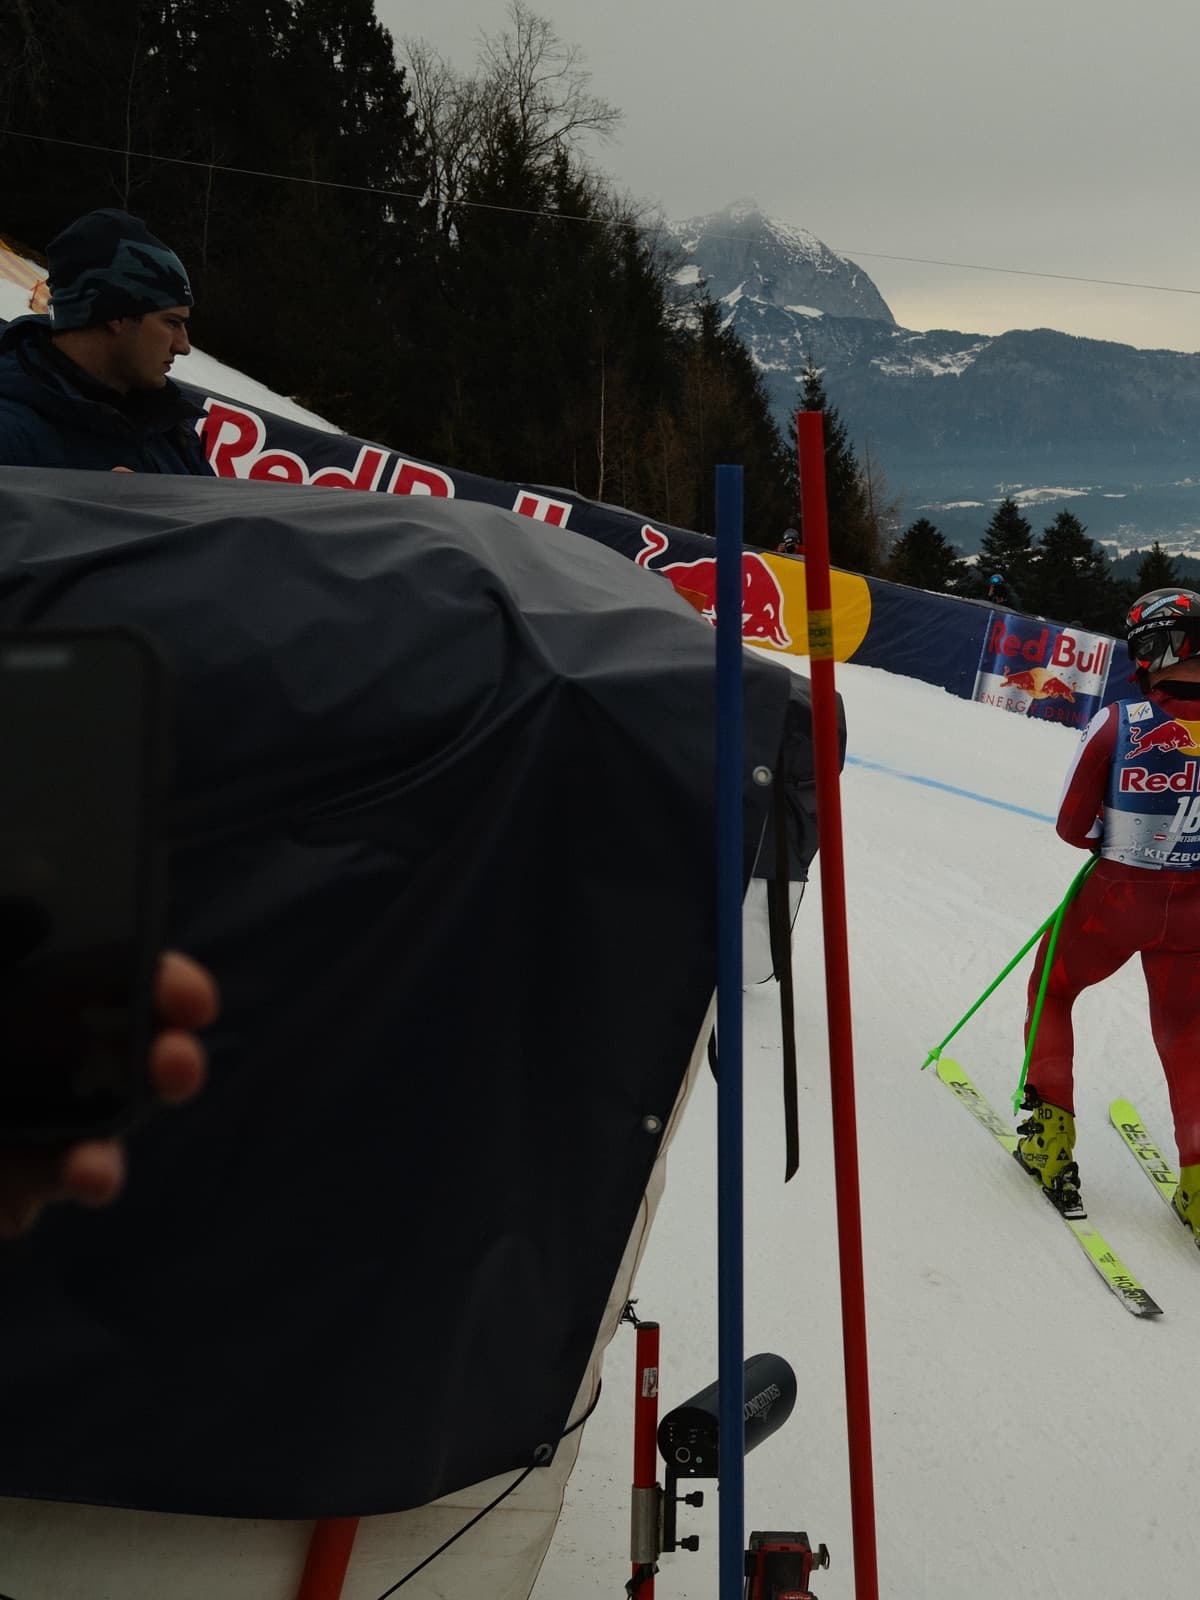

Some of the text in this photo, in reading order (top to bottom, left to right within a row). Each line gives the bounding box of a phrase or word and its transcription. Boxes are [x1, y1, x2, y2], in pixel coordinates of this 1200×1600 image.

[196, 398, 390, 492] Red
[988, 621, 1109, 676] Red Bull
[1119, 761, 1197, 792] Red
